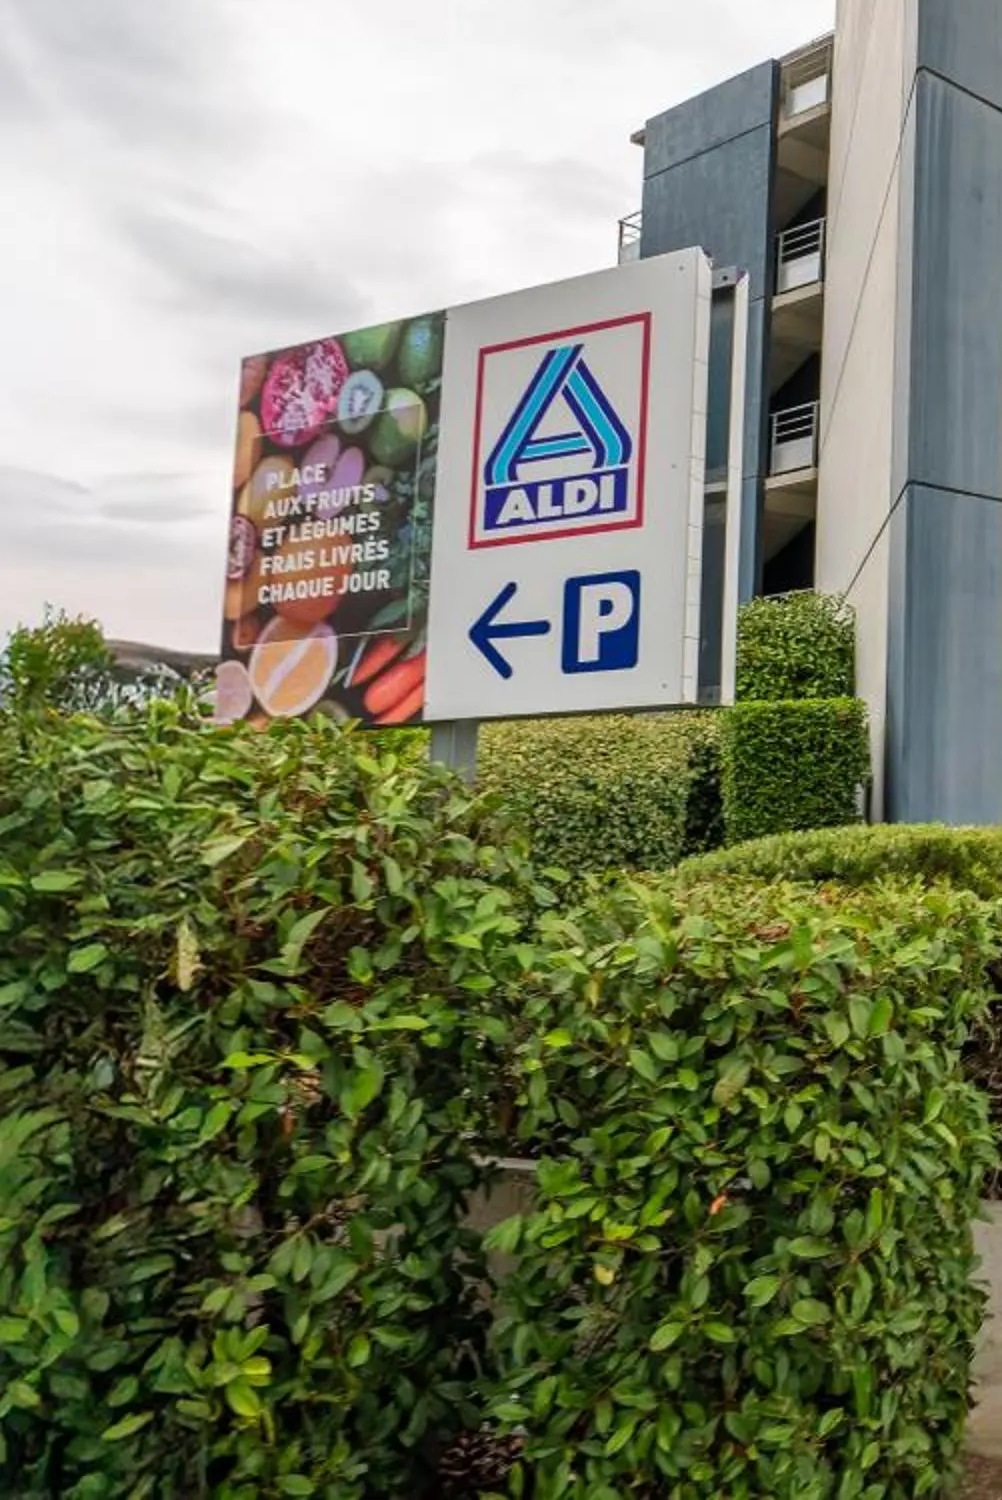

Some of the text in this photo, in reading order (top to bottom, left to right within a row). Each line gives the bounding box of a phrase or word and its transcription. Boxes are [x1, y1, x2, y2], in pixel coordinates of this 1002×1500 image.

[265, 462, 327, 491] PLACE
[263, 483, 376, 519] AUX FRUITS
[495, 474, 616, 525] ALDI
[261, 511, 381, 548] ET LÉGUMES
[260, 535, 390, 577] FRAIS LIVRÉS
[257, 569, 391, 605] CHAQUE JOUR
[576, 581, 634, 664] P
